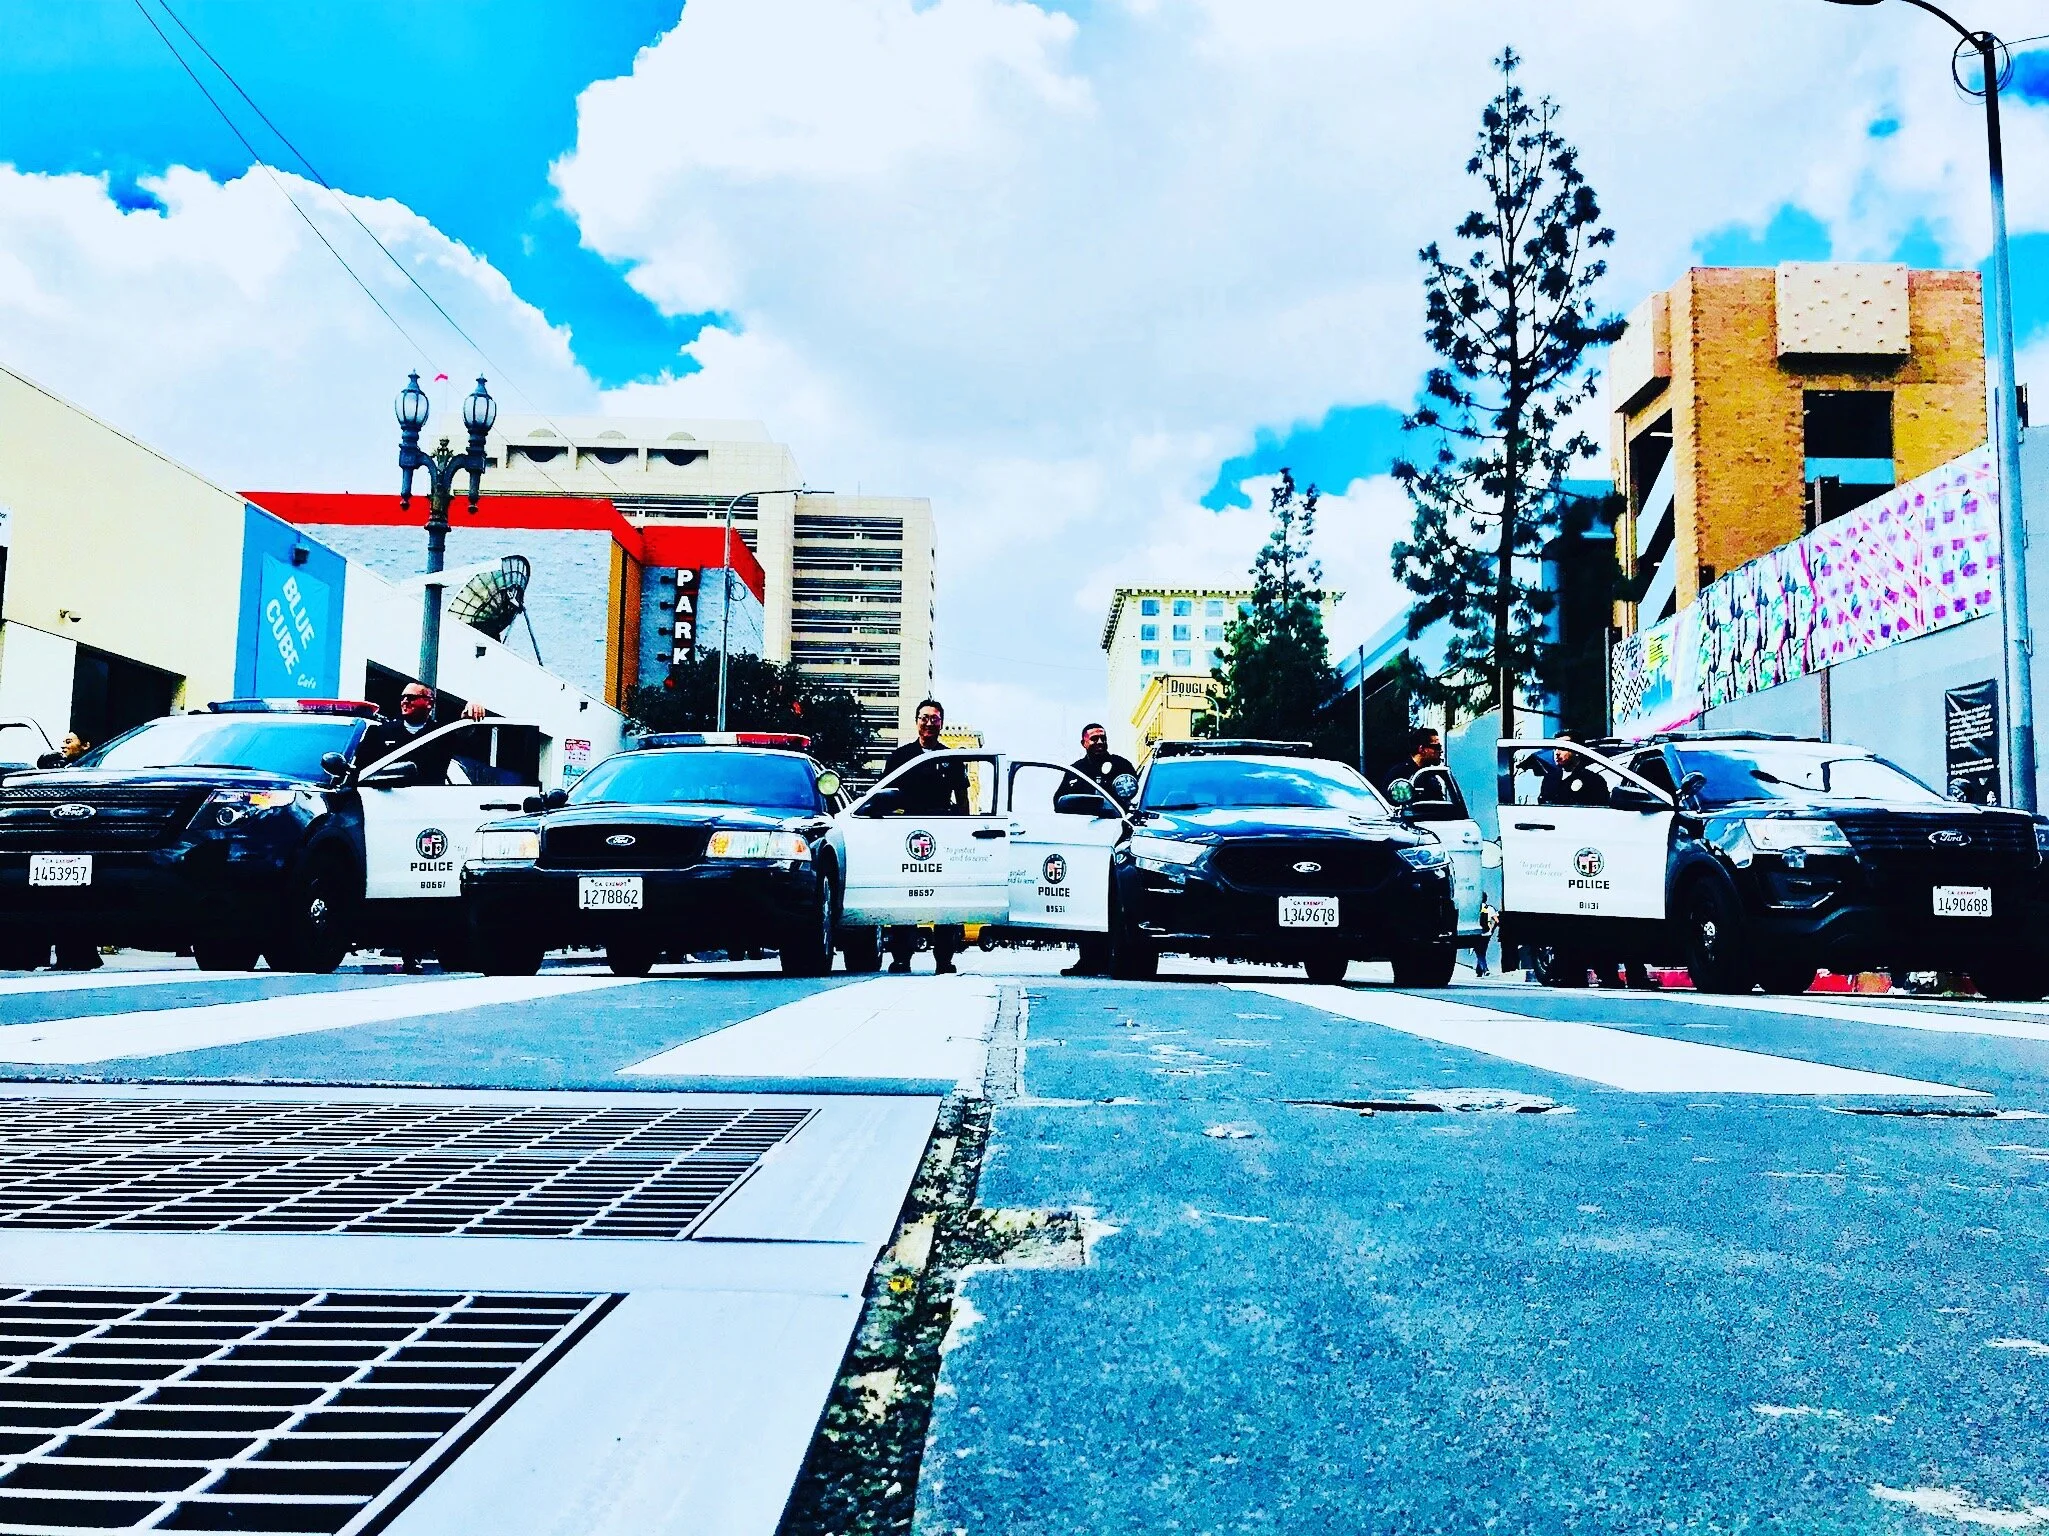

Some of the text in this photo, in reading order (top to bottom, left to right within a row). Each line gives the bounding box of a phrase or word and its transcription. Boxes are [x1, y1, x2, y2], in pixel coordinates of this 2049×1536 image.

[282, 575, 315, 650] BLUE
[673, 569, 694, 665] PARK
[266, 598, 300, 675] CUBE
[1939, 832, 1963, 842] Ford
[33, 866, 87, 881] 1453957
[410, 861, 454, 872] POLICE
[901, 863, 943, 873] POLICE
[1037, 886, 1070, 898] POLICE
[1568, 879, 1610, 890] POLICE
[583, 889, 638, 905] 1278862
[1938, 897, 1988, 912] 1490688
[1283, 907, 1335, 922] 1349678
